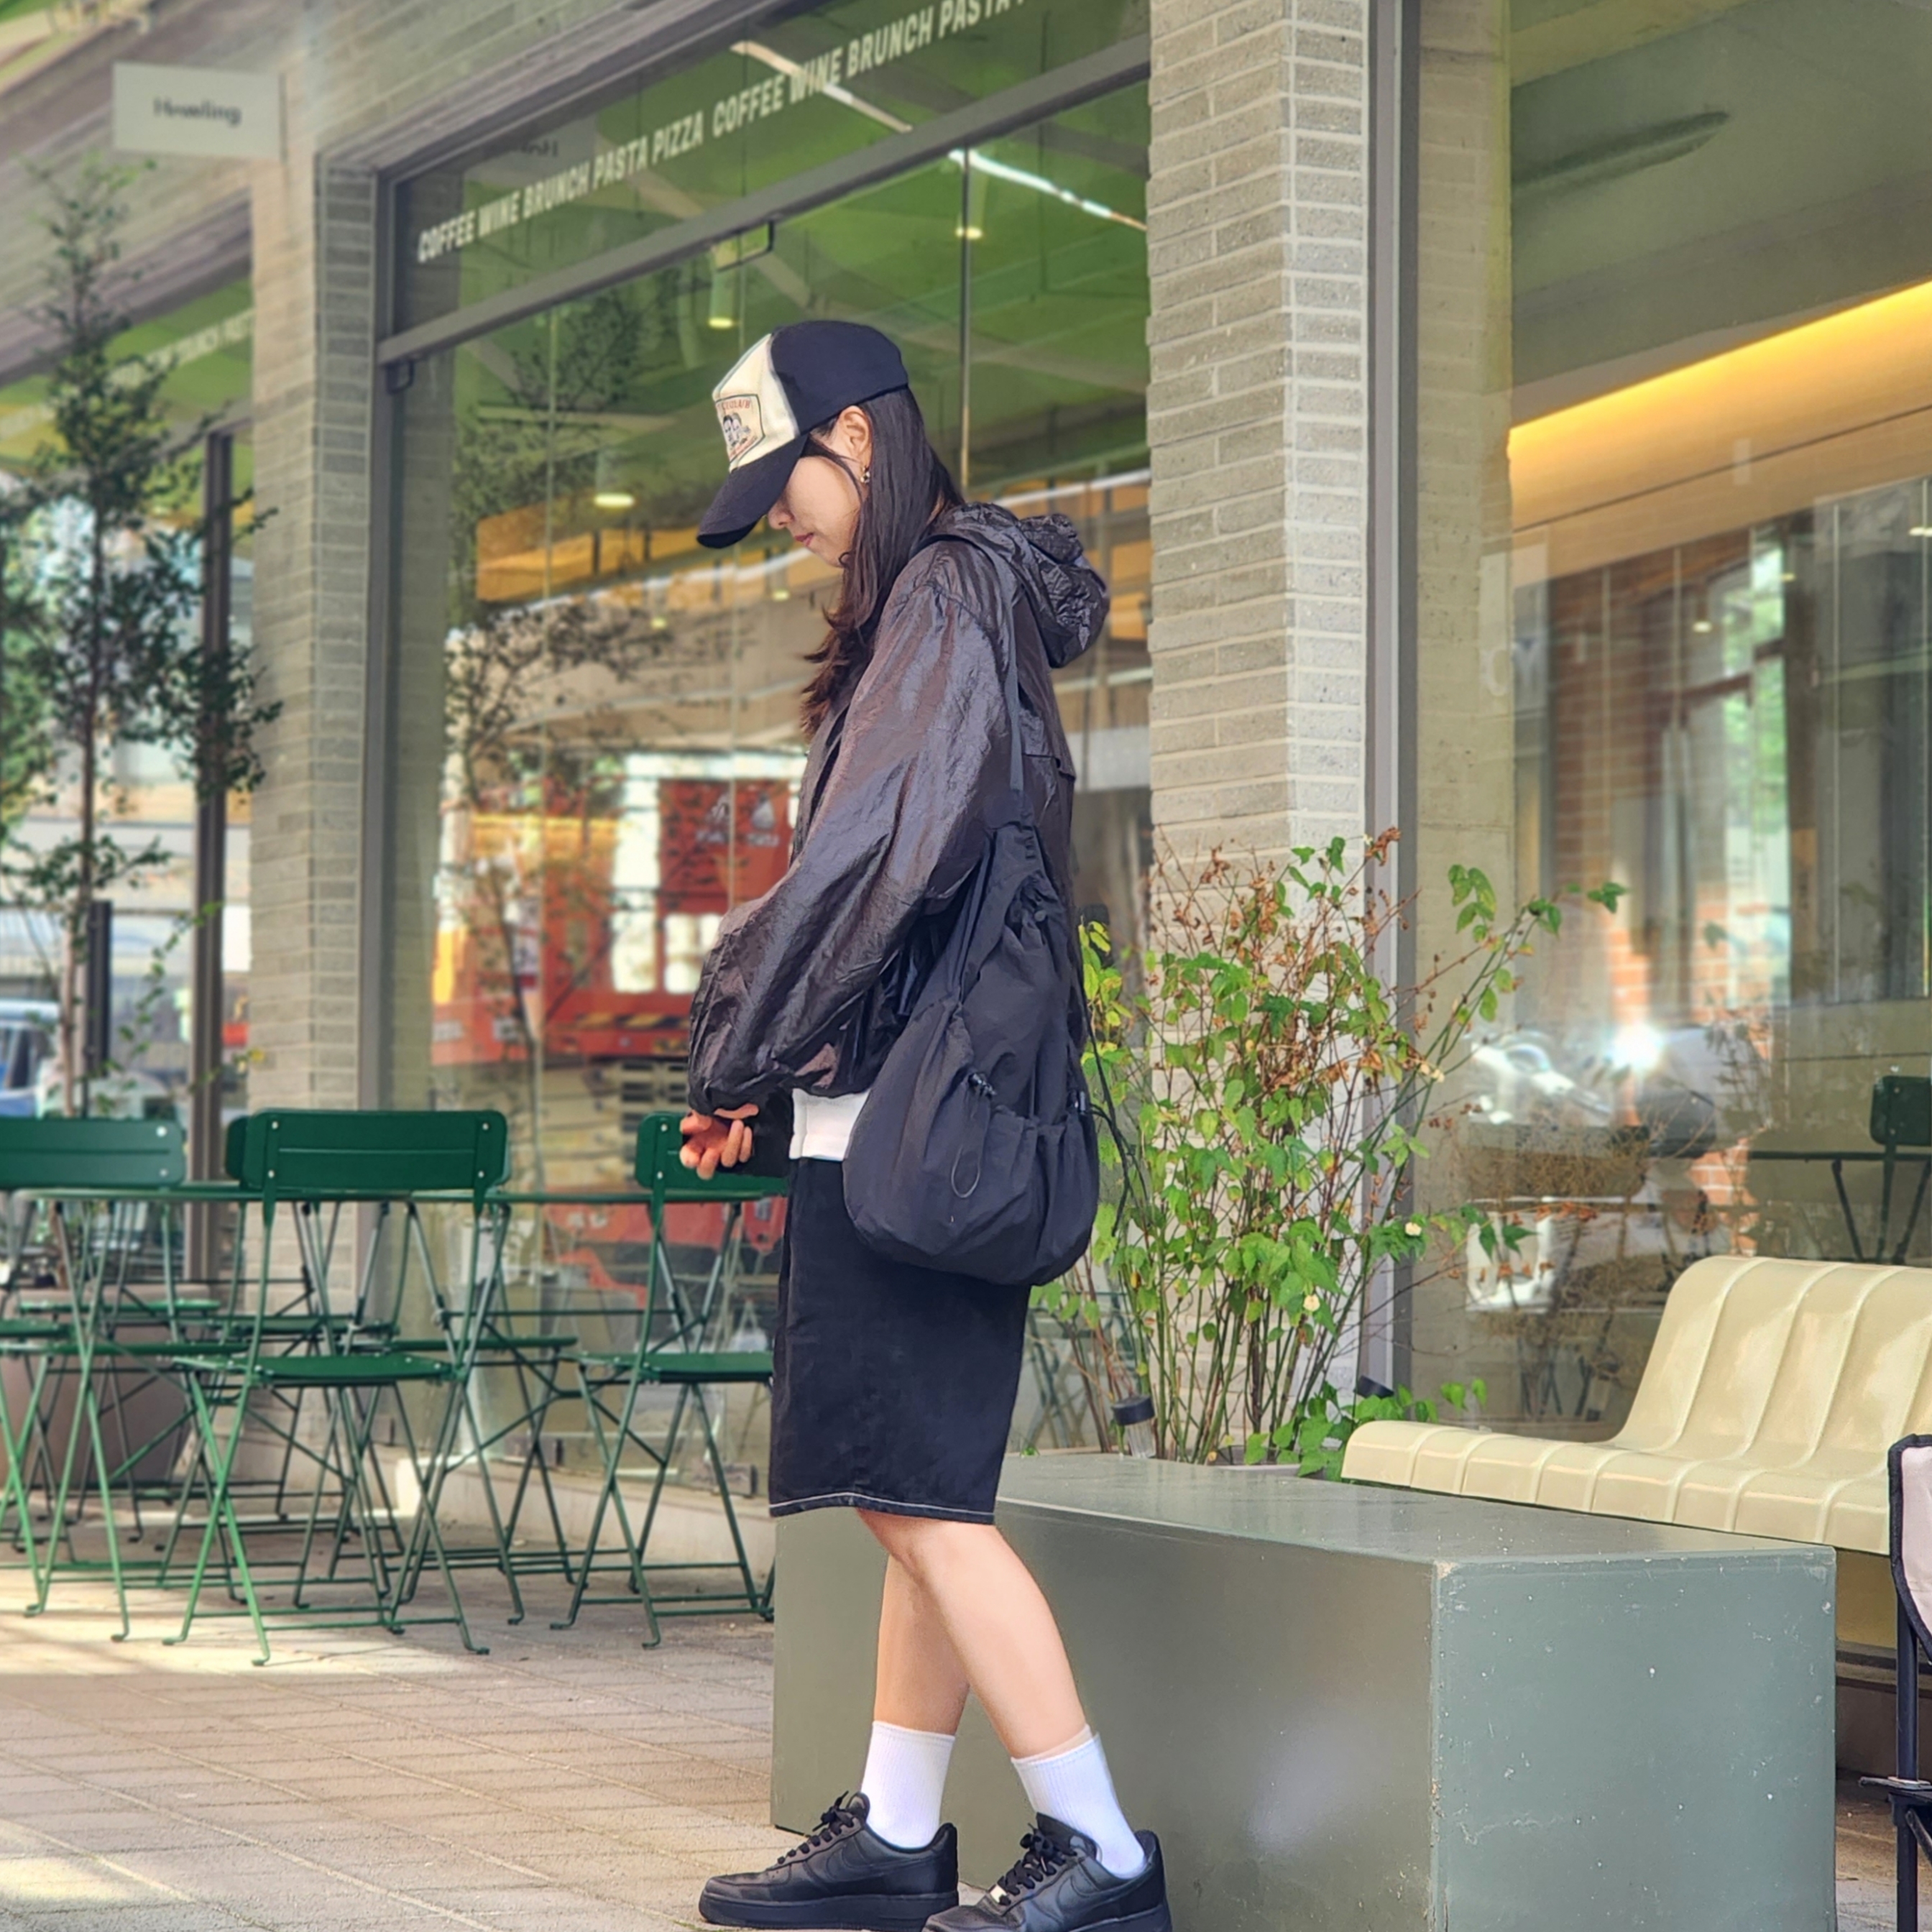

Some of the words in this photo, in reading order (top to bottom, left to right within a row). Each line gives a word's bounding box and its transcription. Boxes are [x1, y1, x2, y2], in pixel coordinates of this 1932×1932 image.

[417, 209, 476, 263] COFFEE
[478, 190, 520, 238] WINE
[523, 161, 592, 219] BRUNCH
[592, 134, 648, 190] PASTA
[652, 110, 704, 166] PIZZA
[712, 74, 785, 138] COFFEE
[791, 46, 844, 104] WINE
[846, 6, 934, 78] BRUNCH
